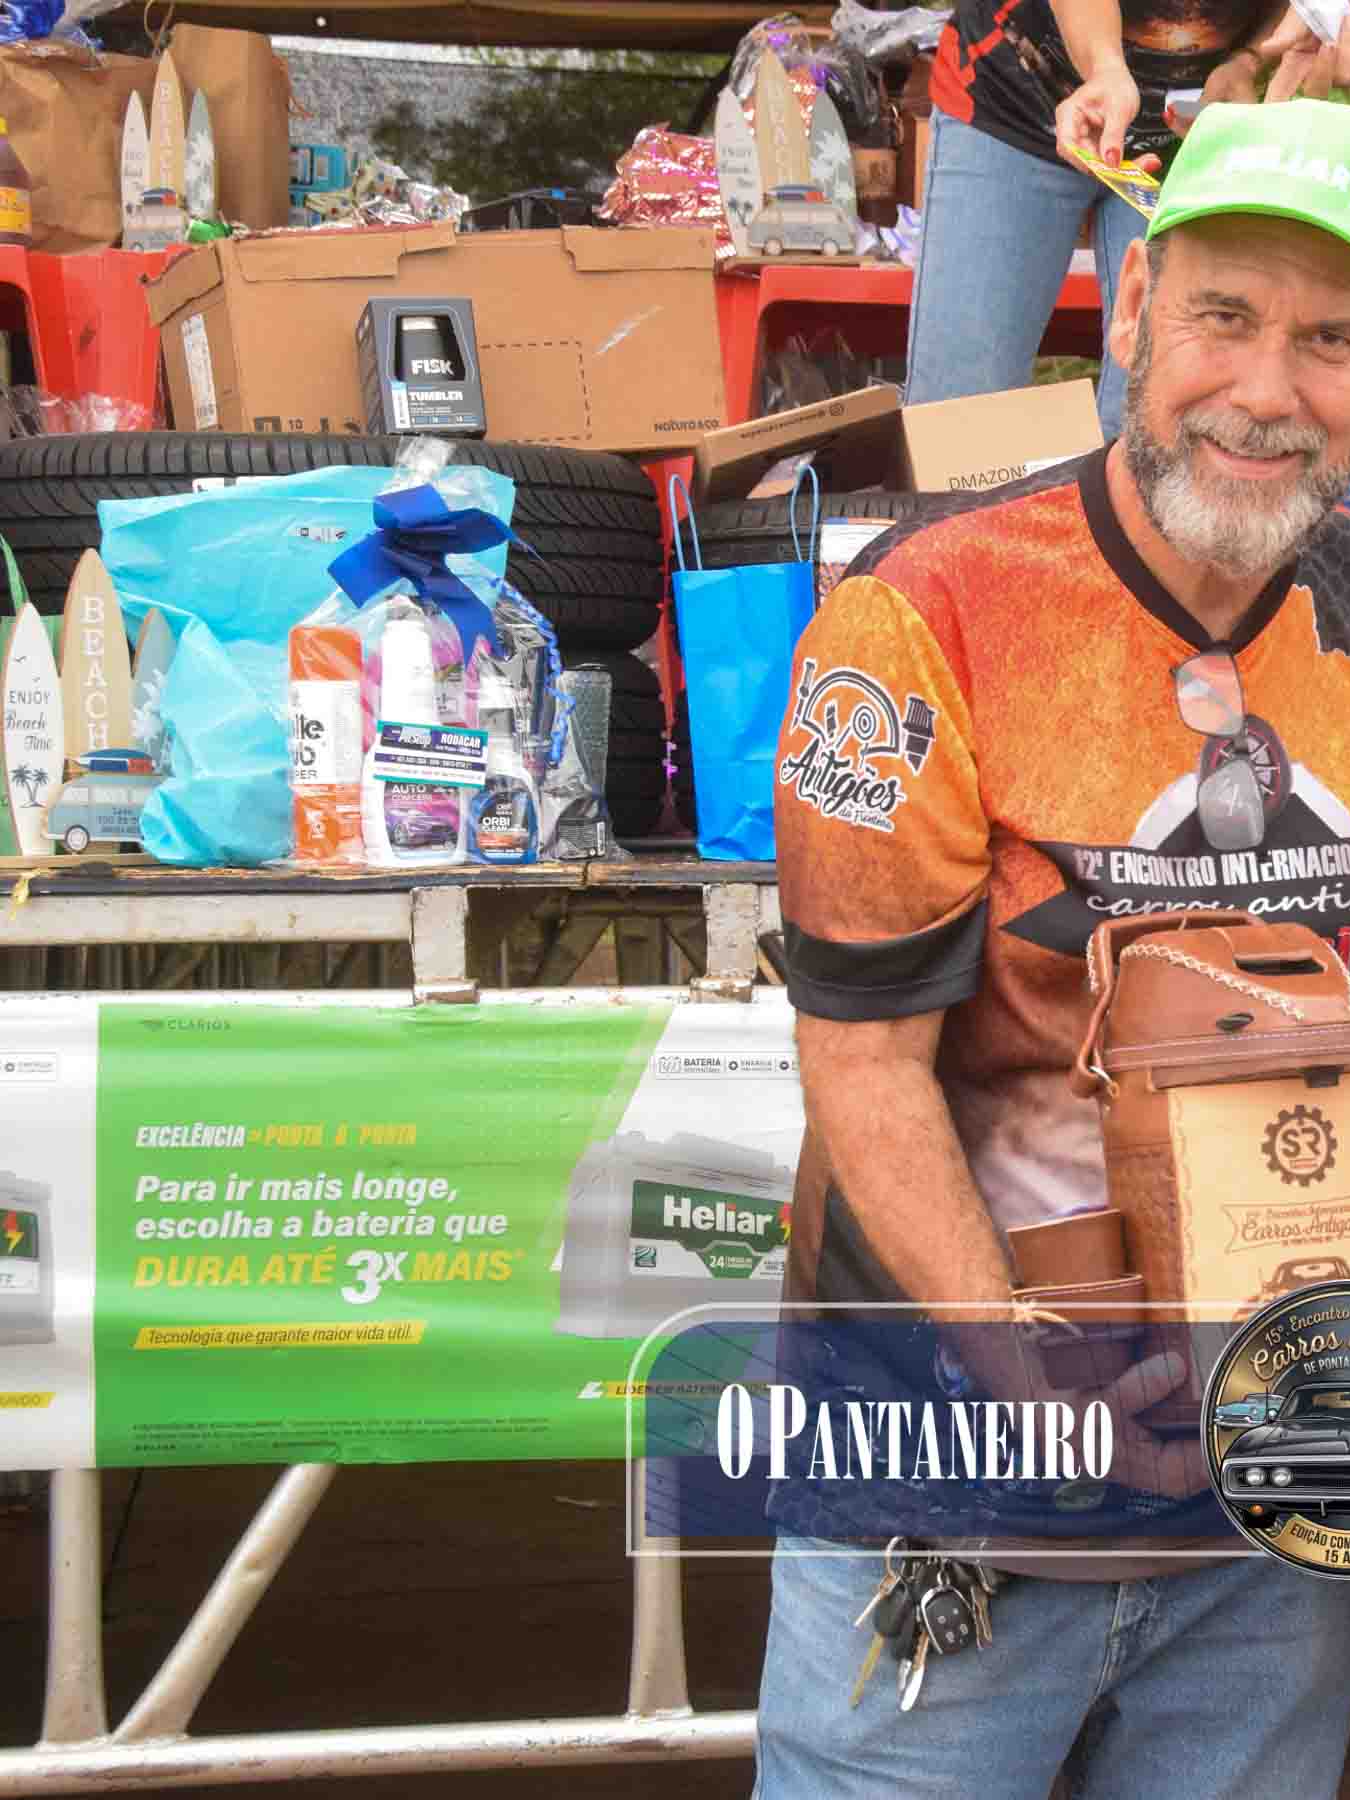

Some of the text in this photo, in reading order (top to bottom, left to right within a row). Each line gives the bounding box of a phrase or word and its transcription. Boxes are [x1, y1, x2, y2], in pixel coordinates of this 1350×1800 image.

[411, 359, 455, 376] FISK
[408, 391, 464, 401] TUMBLER
[83, 594, 109, 750] BEACH
[8, 691, 50, 705] ENJOY
[440, 733, 481, 748] RODACAR
[780, 738, 905, 815] Antigões
[392, 784, 426, 794] AUTO
[482, 816, 510, 826] ORBI
[1110, 851, 1216, 887] ENCONTRO
[684, 1058, 721, 1067] BATERIA
[135, 1122, 245, 1148] EXCELÊNCIA
[135, 1170, 459, 1206] Para ir mais longe,
[135, 1208, 508, 1241] escolha a bateria que
[663, 1194, 773, 1236] Heliar
[134, 1254, 251, 1289] DURA
[260, 1246, 337, 1285] ATÉ
[149, 1330, 223, 1347] Tecnologia
[226, 1332, 251, 1346] que
[254, 1331, 309, 1345] garante
[312, 1328, 353, 1341] maior
[355, 1326, 385, 1340] vida
